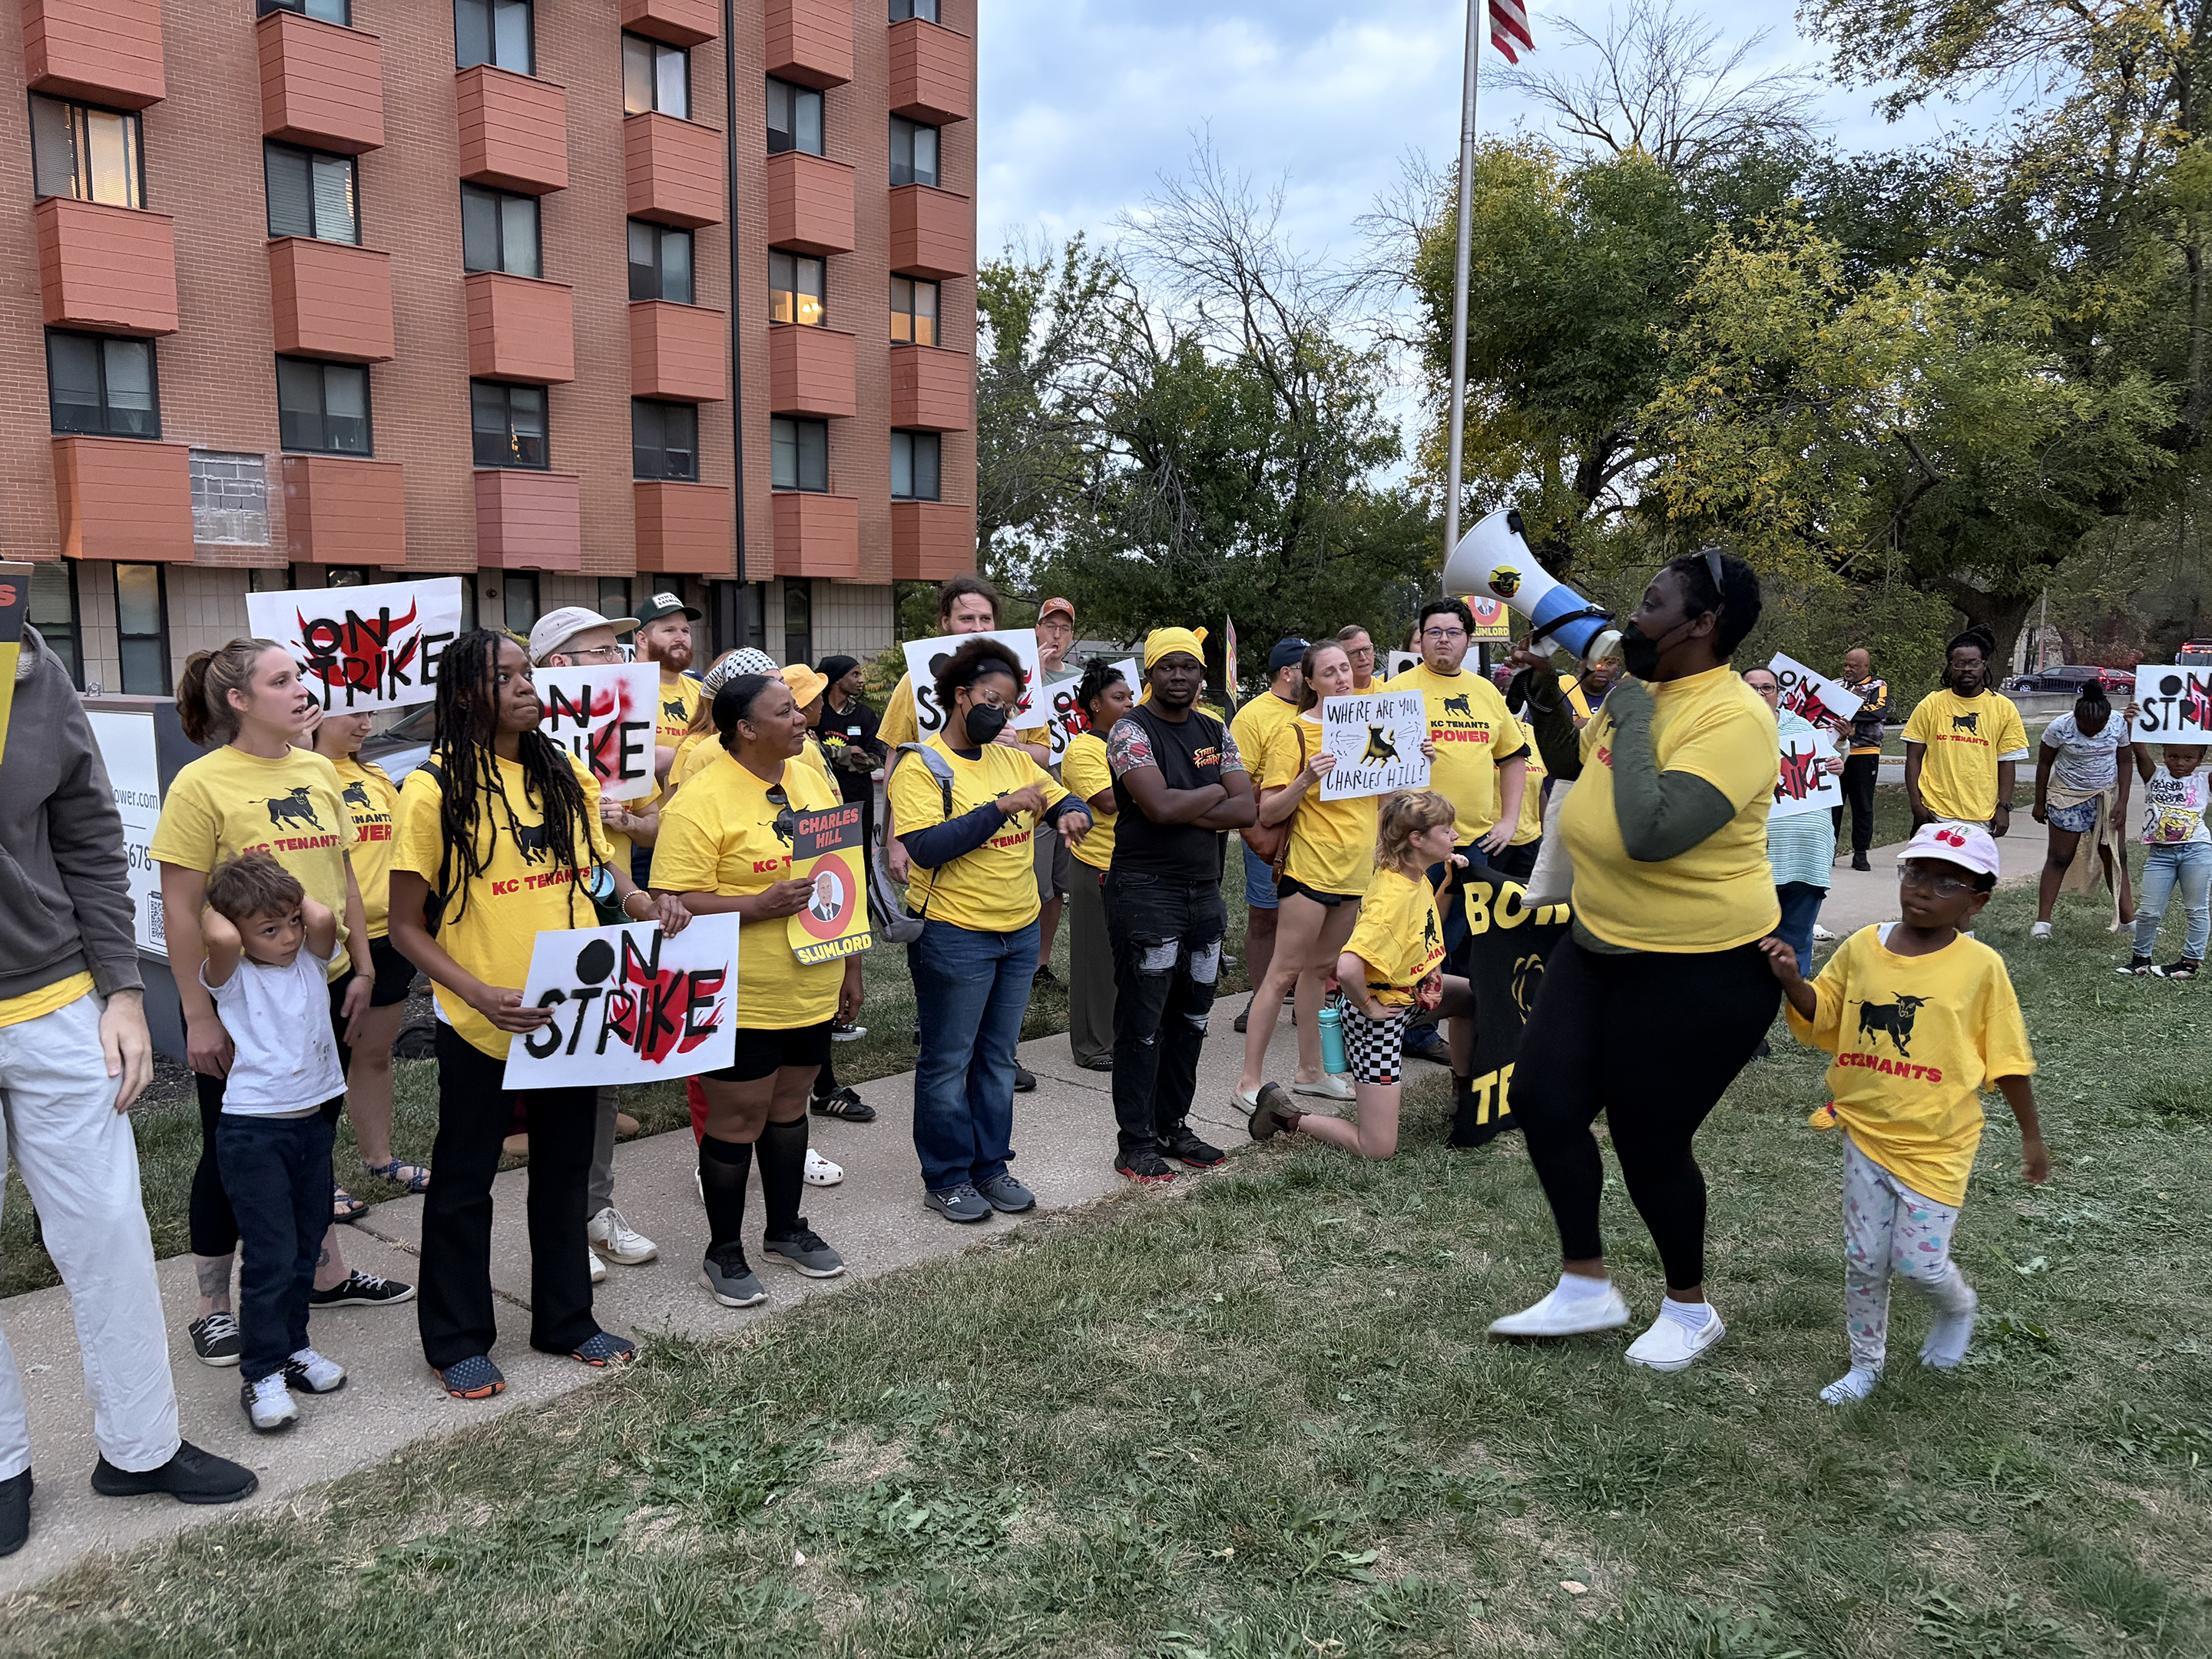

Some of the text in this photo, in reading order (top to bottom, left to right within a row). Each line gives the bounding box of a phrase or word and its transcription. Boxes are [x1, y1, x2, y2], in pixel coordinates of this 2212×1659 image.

[303, 607, 389, 655] ON
[1472, 627, 1508, 637] UMLORD
[1780, 671, 1821, 700] ON
[2160, 672, 2212, 697] ON
[538, 684, 591, 733] N
[1327, 700, 1372, 724] WHERE
[1376, 698, 1395, 719] ARE
[1777, 687, 1842, 729] RIKE
[2140, 697, 2212, 732] STRI
[1048, 712, 1091, 753] STR
[1431, 730, 1490, 743] POWER
[1445, 720, 1490, 729] TENANTS
[549, 720, 651, 780] IKE
[1950, 735, 1989, 747] TENANTS
[1193, 747, 1215, 761] STREET
[1326, 757, 1426, 791] CHARLES HILL?
[1773, 758, 1833, 804] RIKE
[352, 813, 392, 824] NANT
[799, 808, 859, 836] CHARLES
[273, 834, 341, 852] TENANT
[353, 824, 392, 843] WER
[816, 833, 843, 849] HILL
[991, 830, 1031, 849] TENANT
[753, 859, 778, 873] KC
[492, 879, 519, 896] KC
[576, 929, 663, 985] ON
[797, 933, 873, 963] SLUMLORD
[1410, 963, 1424, 975] KC
[525, 969, 723, 1059] STRIKE
